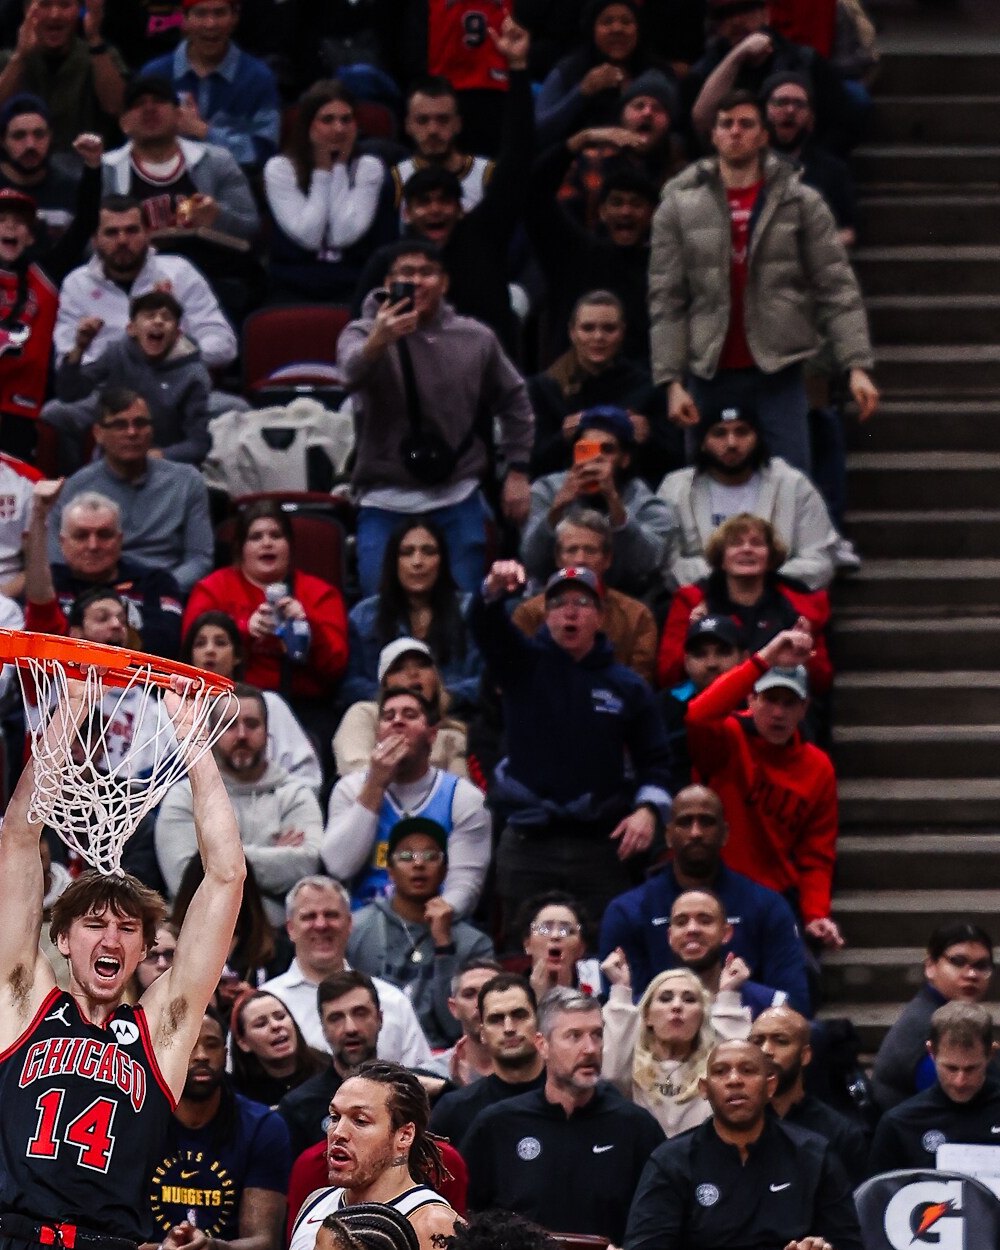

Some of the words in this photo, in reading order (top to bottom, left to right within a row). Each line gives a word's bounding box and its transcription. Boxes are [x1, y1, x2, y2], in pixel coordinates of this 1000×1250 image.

[461, 10, 488, 49] 9
[18, 1037, 147, 1113] CHICAGO
[26, 1087, 118, 1174] 14
[161, 1185, 222, 1207] NUGGETS
